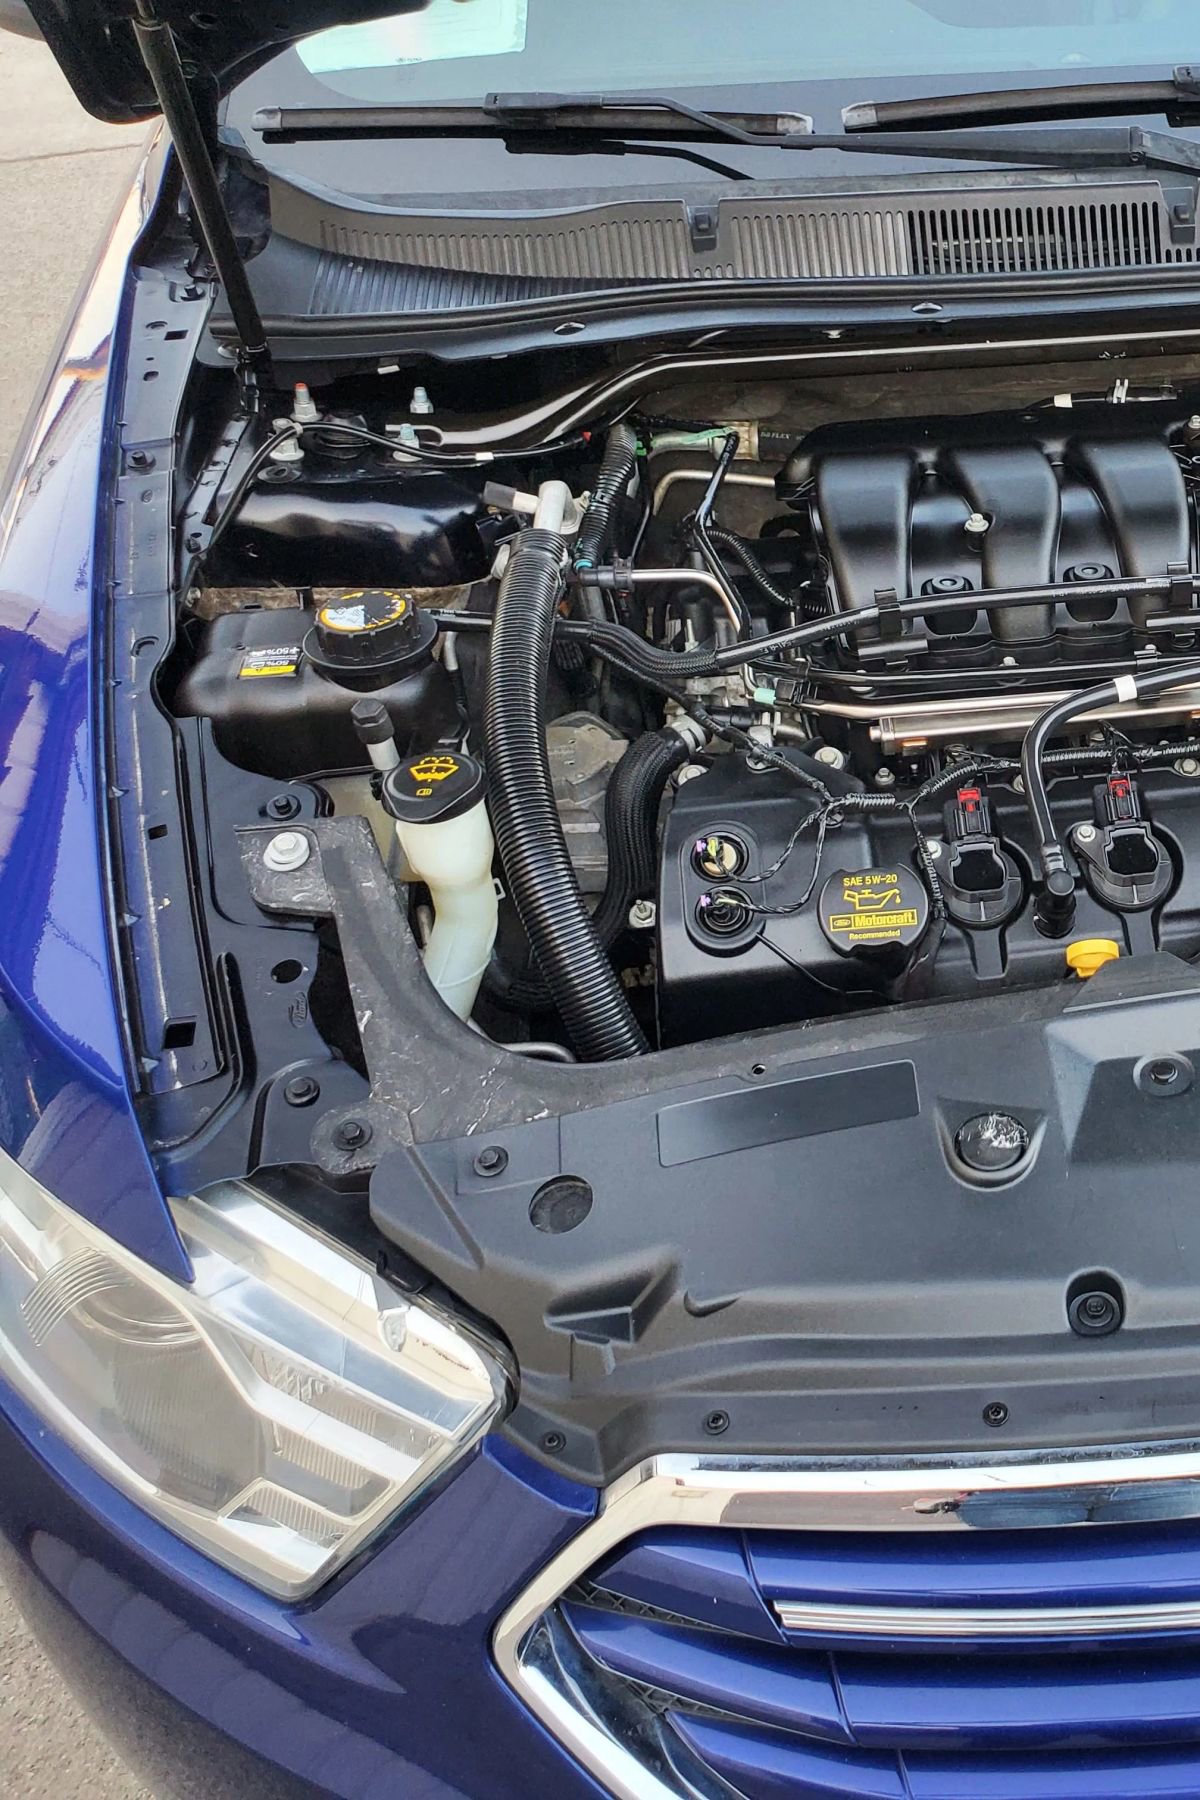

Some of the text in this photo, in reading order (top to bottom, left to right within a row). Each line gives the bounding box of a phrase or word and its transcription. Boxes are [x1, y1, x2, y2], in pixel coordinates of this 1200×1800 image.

[843, 874, 898, 887] SAE 5W-20
[855, 912, 914, 928] Motorcraft
[849, 929, 901, 940] Recommended
